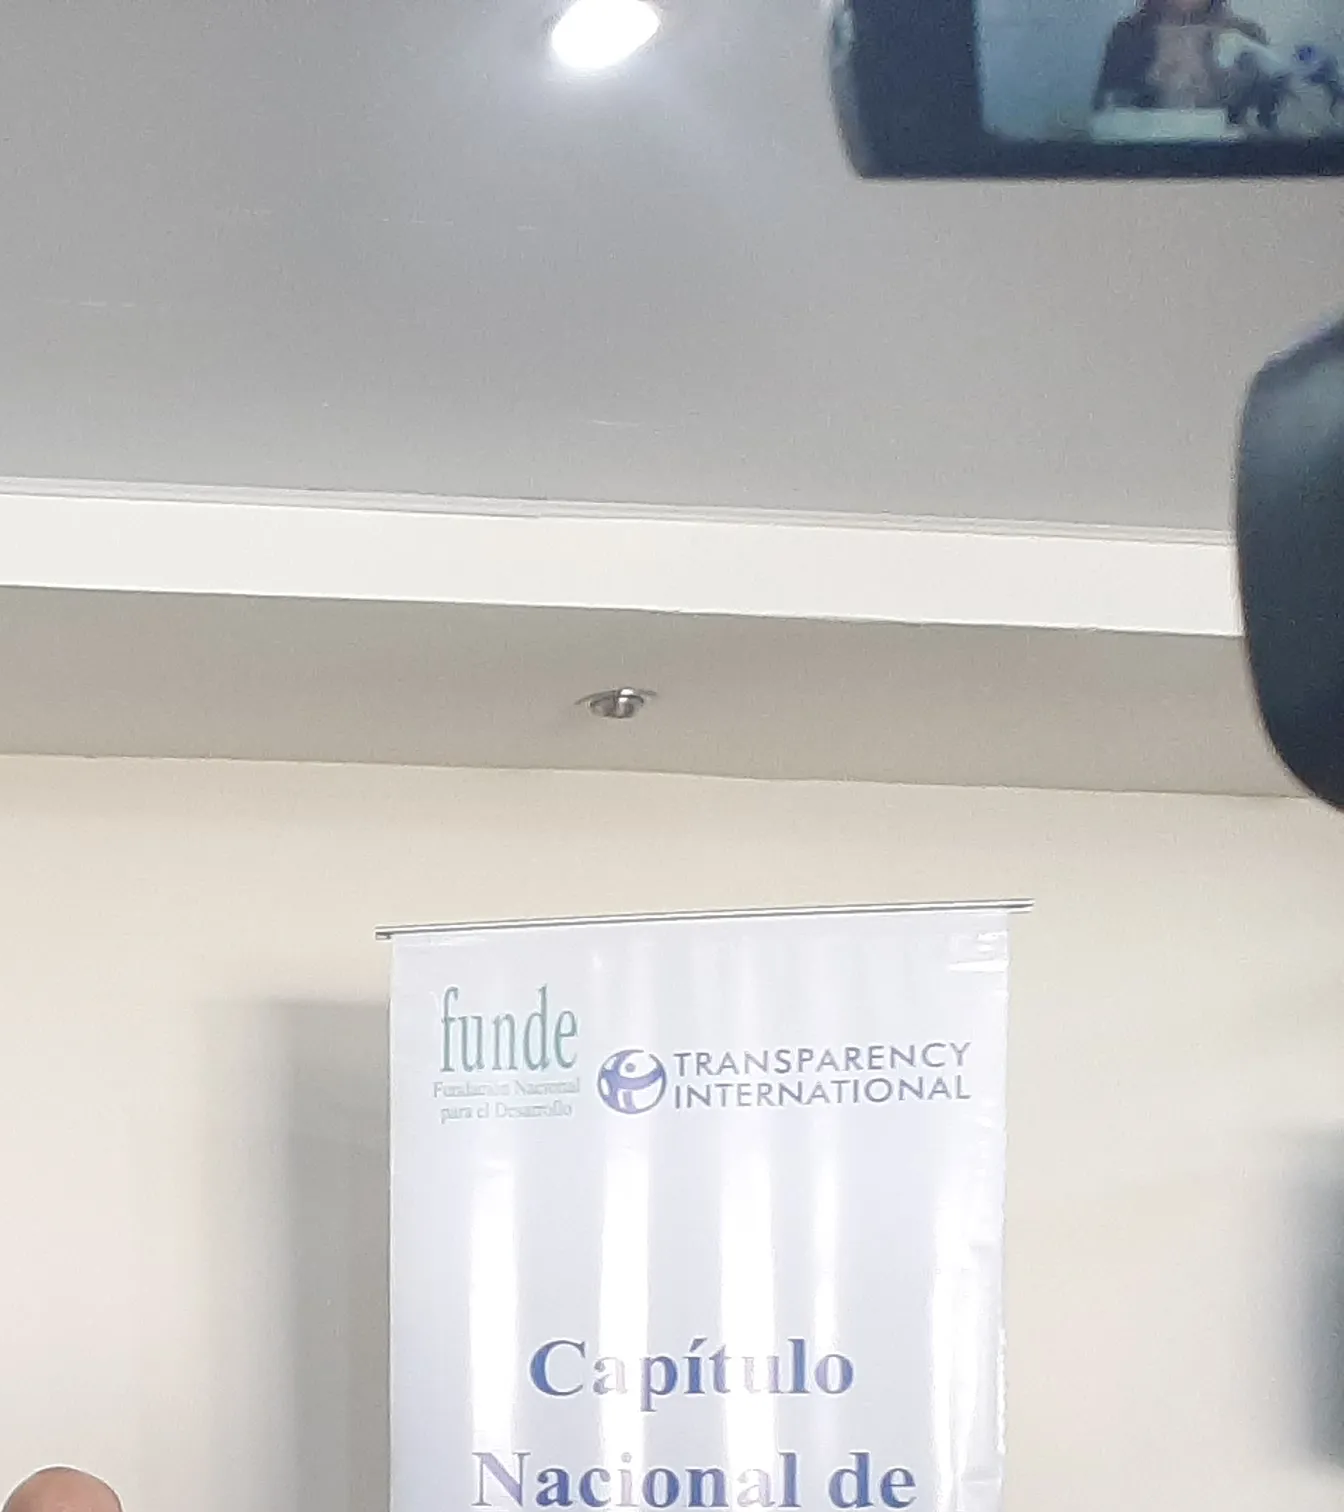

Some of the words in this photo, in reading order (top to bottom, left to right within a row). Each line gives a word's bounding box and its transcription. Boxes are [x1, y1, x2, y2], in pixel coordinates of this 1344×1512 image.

[439, 982, 579, 1073] funde
[672, 1041, 972, 1078] TRANSPARENCY
[673, 1074, 972, 1110] INTERNATIONAL
[528, 1336, 854, 1412] Capítulo
[472, 1450, 802, 1510] Nacional
[827, 1450, 917, 1509] de
